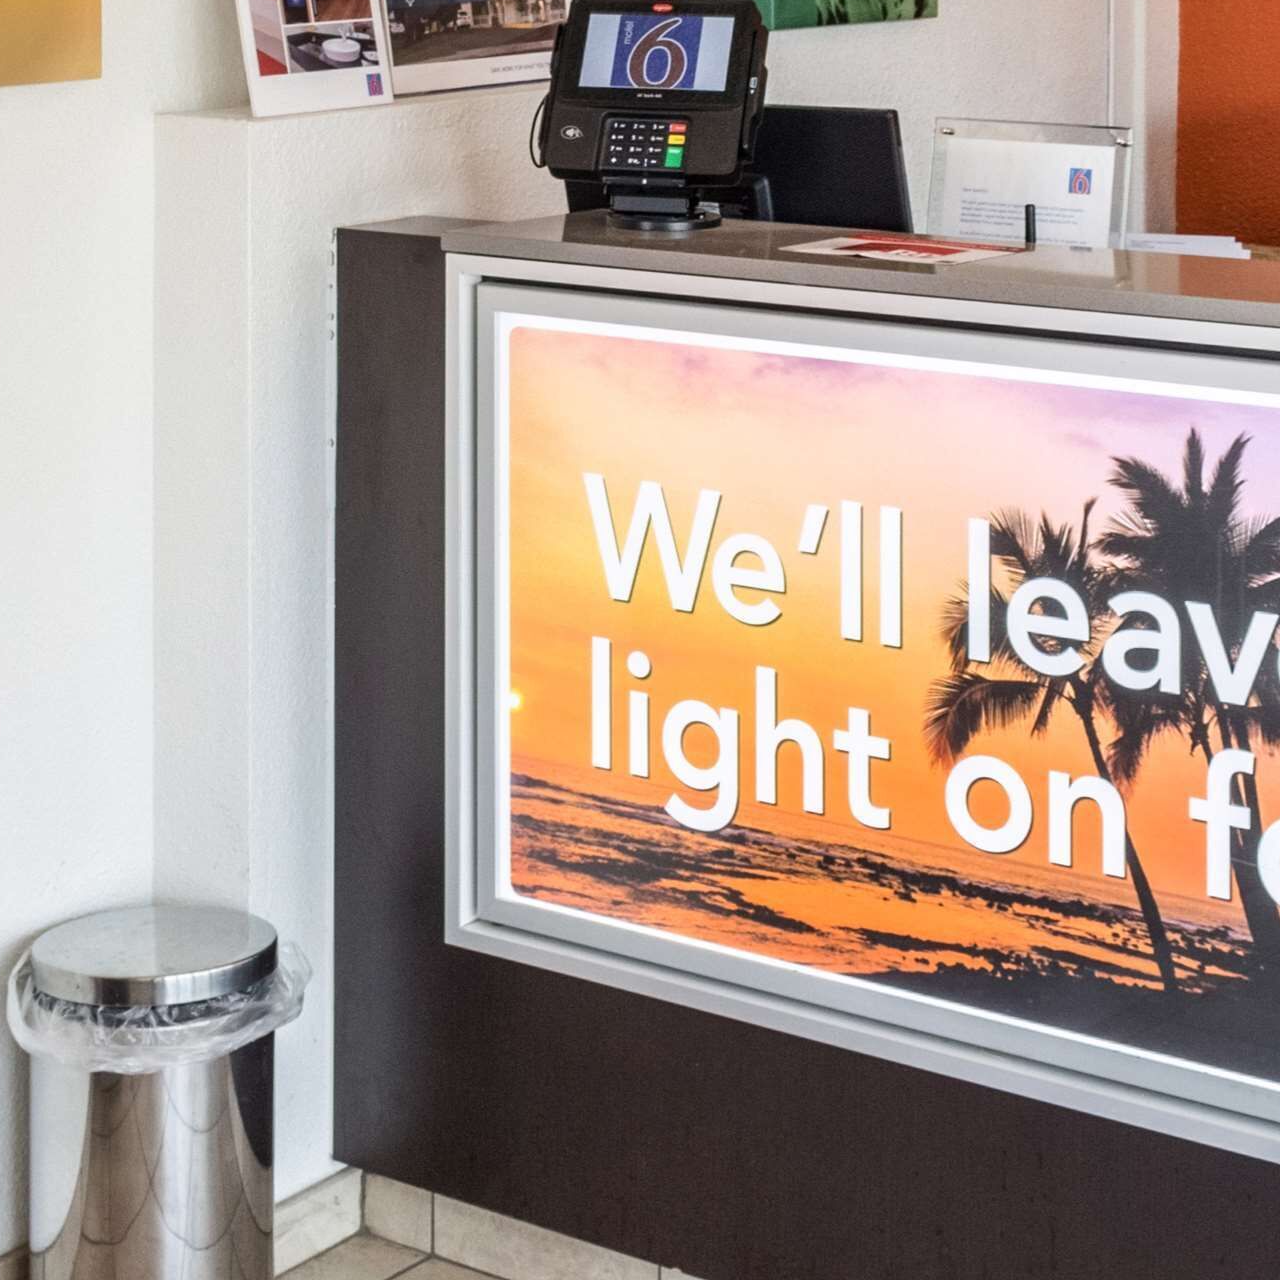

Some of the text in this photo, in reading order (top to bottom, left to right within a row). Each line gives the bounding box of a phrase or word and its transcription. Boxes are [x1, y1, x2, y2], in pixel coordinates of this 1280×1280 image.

[626, 16, 688, 90] 6
[582, 471, 904, 649] We'll
[589, 636, 892, 833] light
[944, 752, 1128, 878] on
